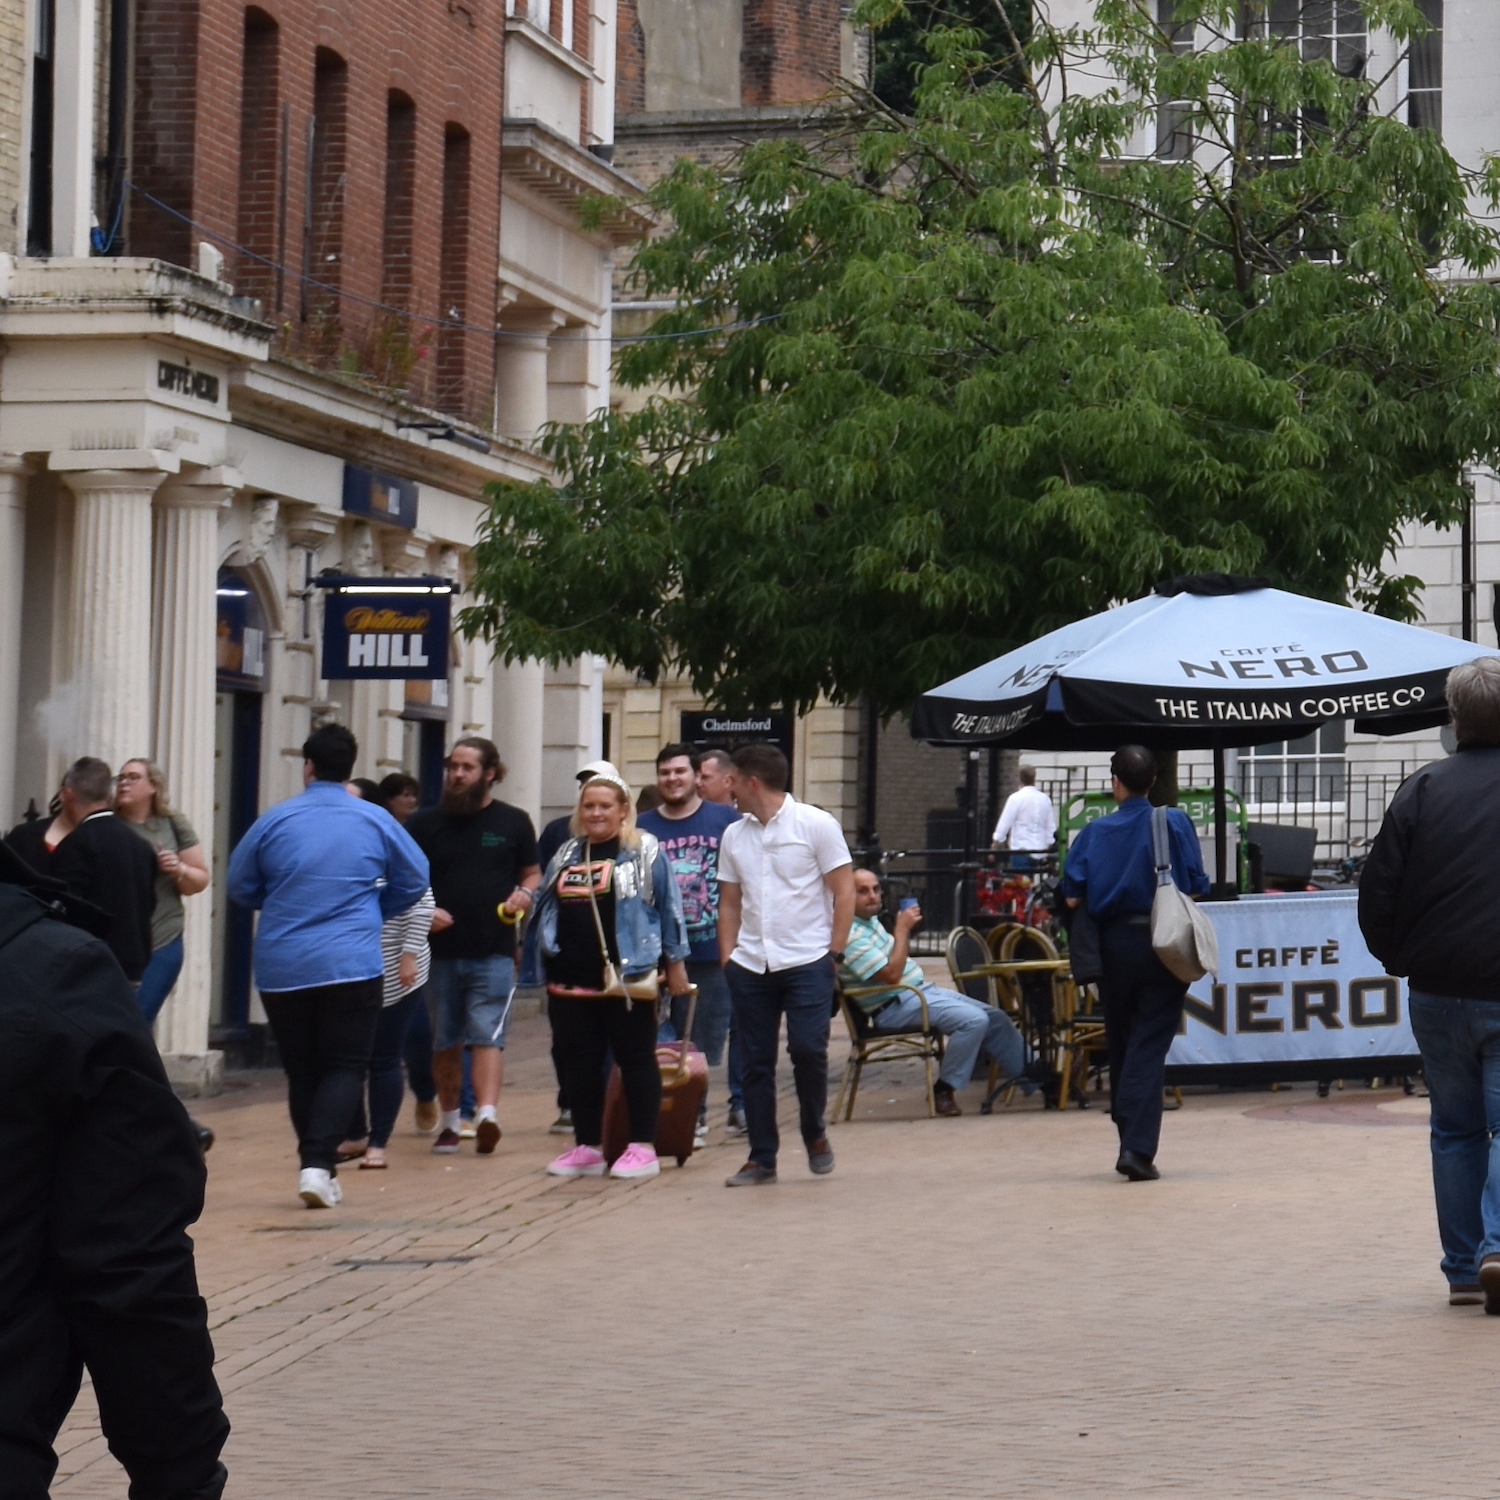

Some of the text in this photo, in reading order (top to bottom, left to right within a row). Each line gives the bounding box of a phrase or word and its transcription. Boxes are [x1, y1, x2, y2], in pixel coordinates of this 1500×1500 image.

[344, 606, 431, 632] William
[348, 633, 429, 667] HILL
[1219, 642, 1304, 656] CAFFÈ
[1178, 649, 1369, 680] NERO
[1156, 698, 1199, 719] THE
[1207, 701, 1293, 720] ITALIAN
[1300, 691, 1390, 718] COFFEE
[702, 717, 772, 732] Chelmsford
[951, 712, 979, 734] THE
[1236, 938, 1339, 969] CAFFÈ
[1175, 975, 1401, 1036] NERO
